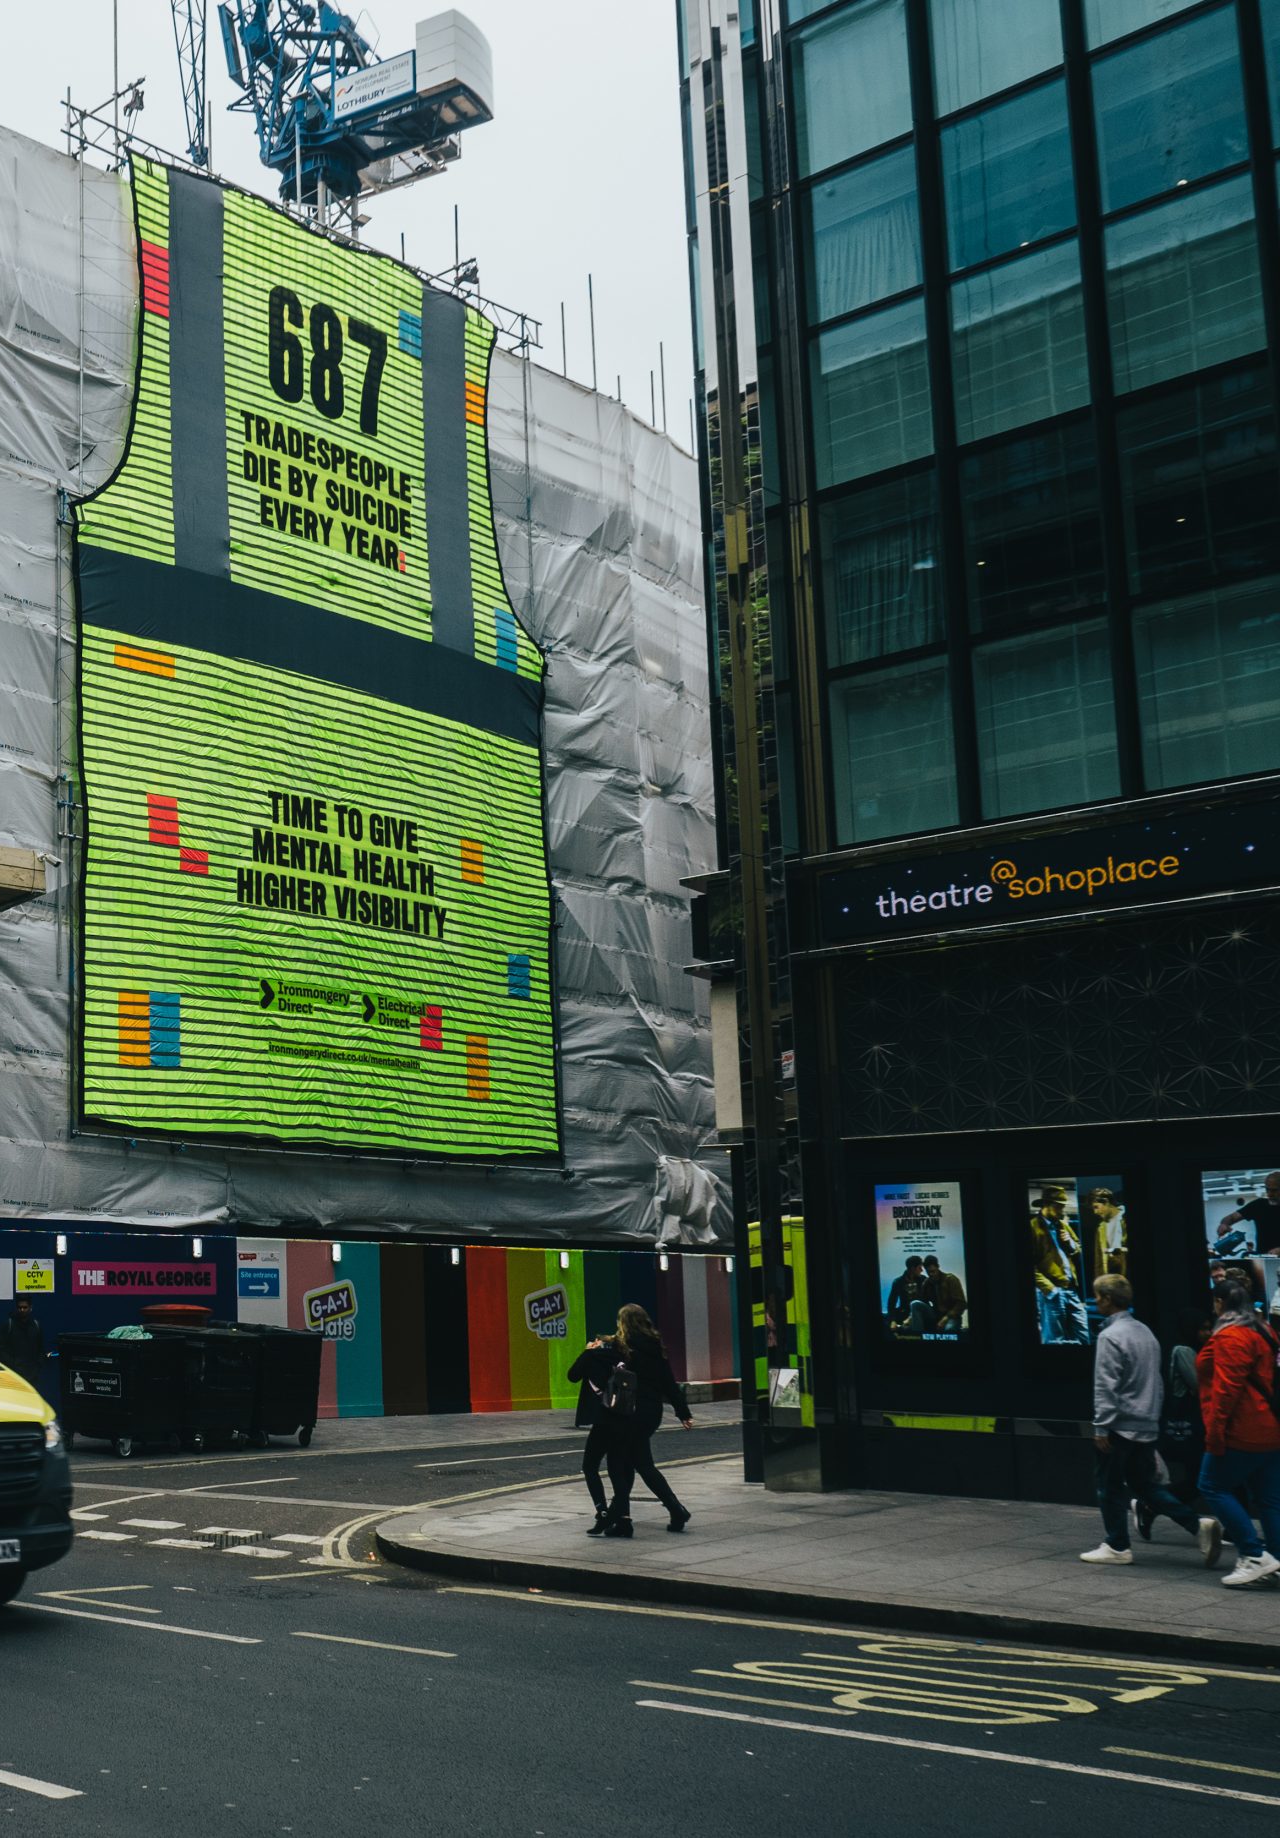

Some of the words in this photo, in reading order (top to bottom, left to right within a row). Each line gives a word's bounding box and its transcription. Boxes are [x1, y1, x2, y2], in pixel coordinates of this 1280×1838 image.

[337, 87, 386, 112] LOTHBURY
[268, 285, 388, 437] 687
[240, 410, 411, 503] TRADESPEOPLE
[243, 449, 282, 491] DIE
[288, 463, 317, 502] BY
[326, 478, 412, 540] SUICIDE
[260, 494, 333, 548] EVERY
[341, 522, 399, 572] YEAR
[268, 790, 327, 834] TIME
[333, 805, 363, 841] TO
[369, 813, 418, 854] GIVE
[253, 829, 347, 878] MENTAL
[353, 853, 434, 897] HEALTH
[237, 868, 327, 917] HIGHER
[334, 886, 447, 939] VISIBILITY
[875, 883, 994, 918] theatre
[277, 981, 351, 1007] Ironmongery
[278, 998, 313, 1014] Direct
[378, 996, 426, 1016] Electrical
[378, 1012, 410, 1029] Direct
[268, 1041, 421, 1070] ironmongerydirect.co.uk/mentalhealth
[892, 1205, 943, 1219] BROKEBACK
[896, 1218, 940, 1231] MOUNTAIN
[78, 1269, 105, 1286] THE
[107, 1270, 154, 1287] ROYAL
[156, 1270, 211, 1287] GEORGE
[240, 1271, 251, 1279] Site
[310, 1290, 349, 1318] G-A-Y
[531, 1293, 562, 1320] G-A-Y
[538, 1317, 567, 1336] Late
[936, 1333, 958, 1341] PLAYING
[89, 1377, 118, 1385] commercial
[691, 1643, 1208, 1724] STOP
